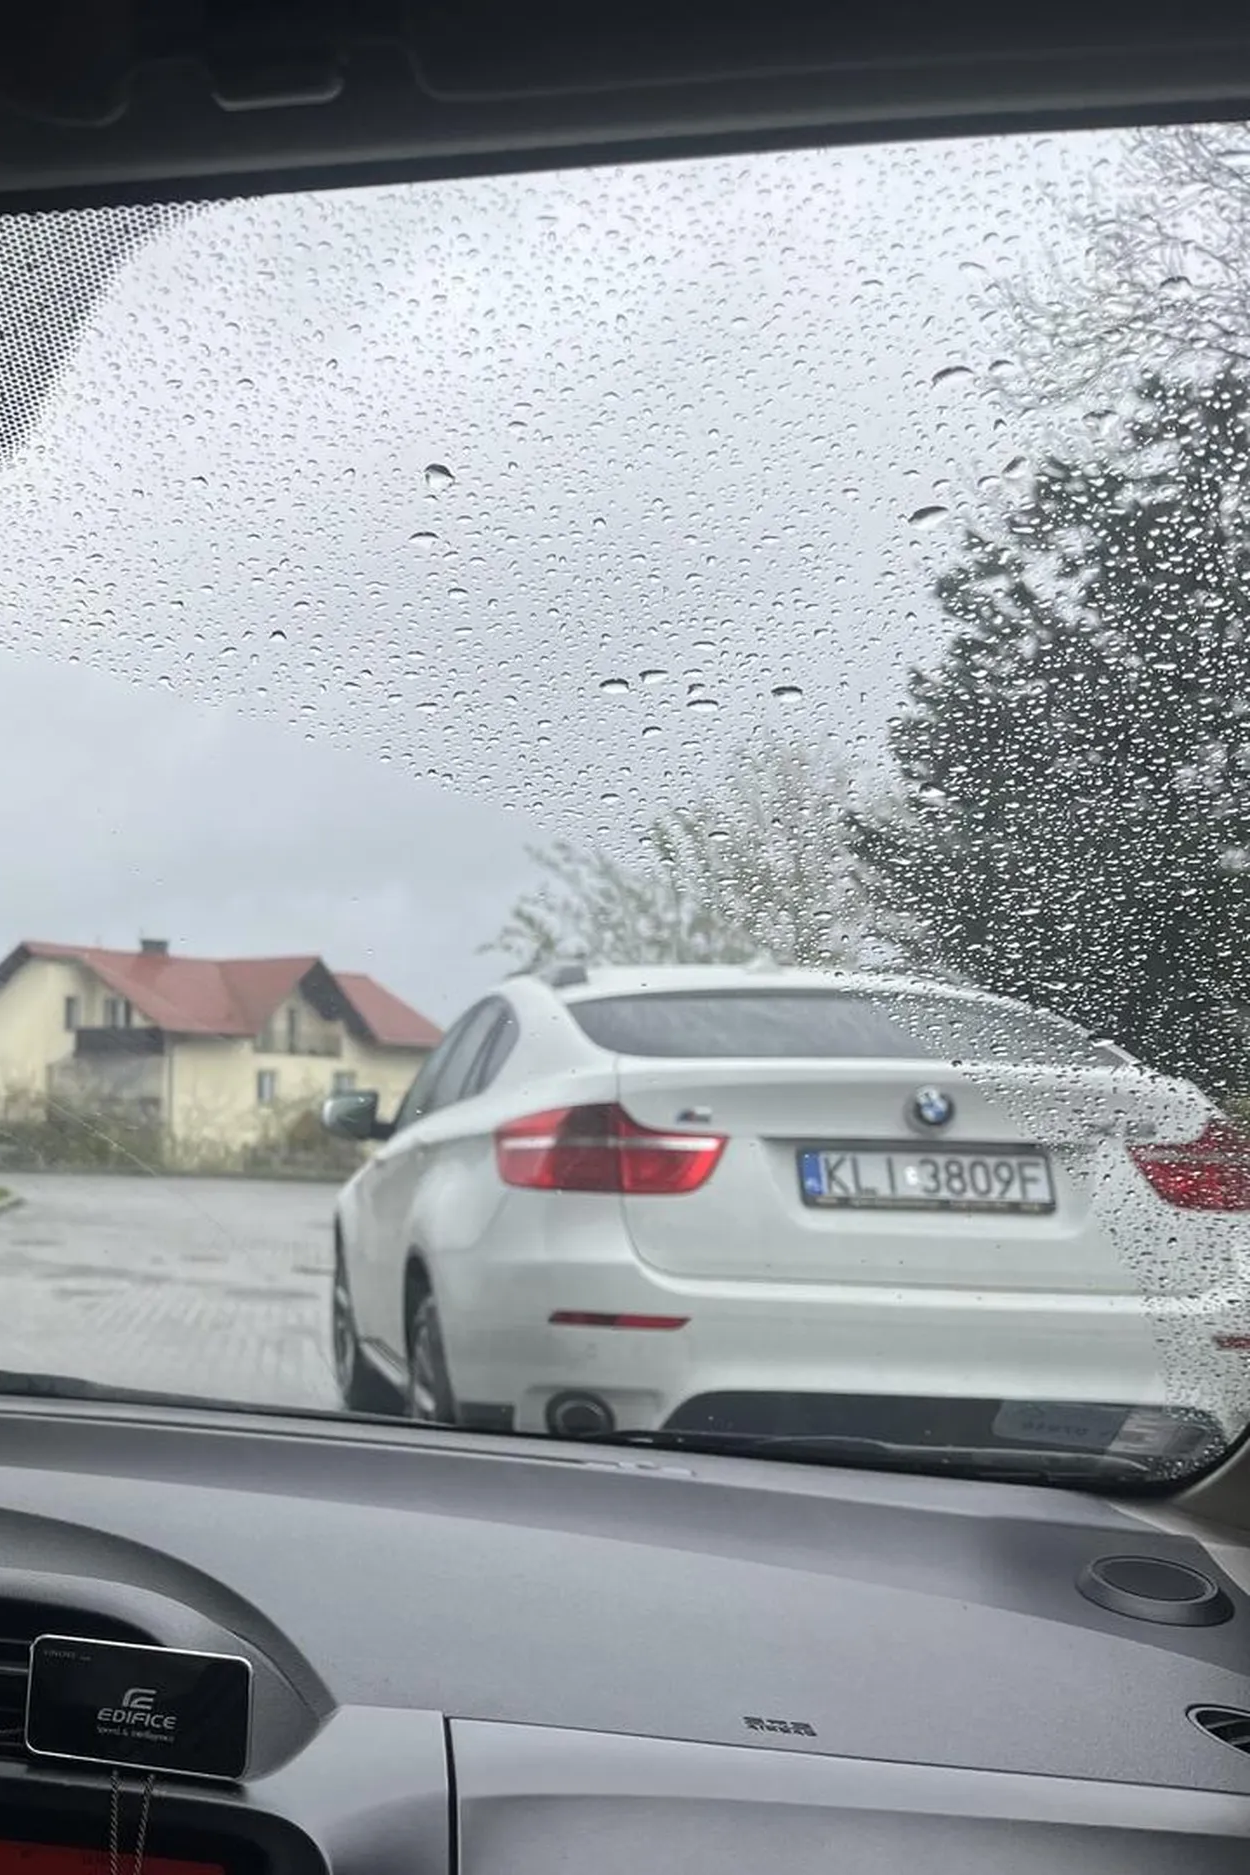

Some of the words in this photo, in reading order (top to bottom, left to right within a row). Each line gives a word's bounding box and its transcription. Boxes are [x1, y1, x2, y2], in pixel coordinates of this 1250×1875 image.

[824, 1156, 897, 1197] KLI
[918, 1158, 1041, 1200] 3809F
[97, 1707, 177, 1730] EDIFICE
